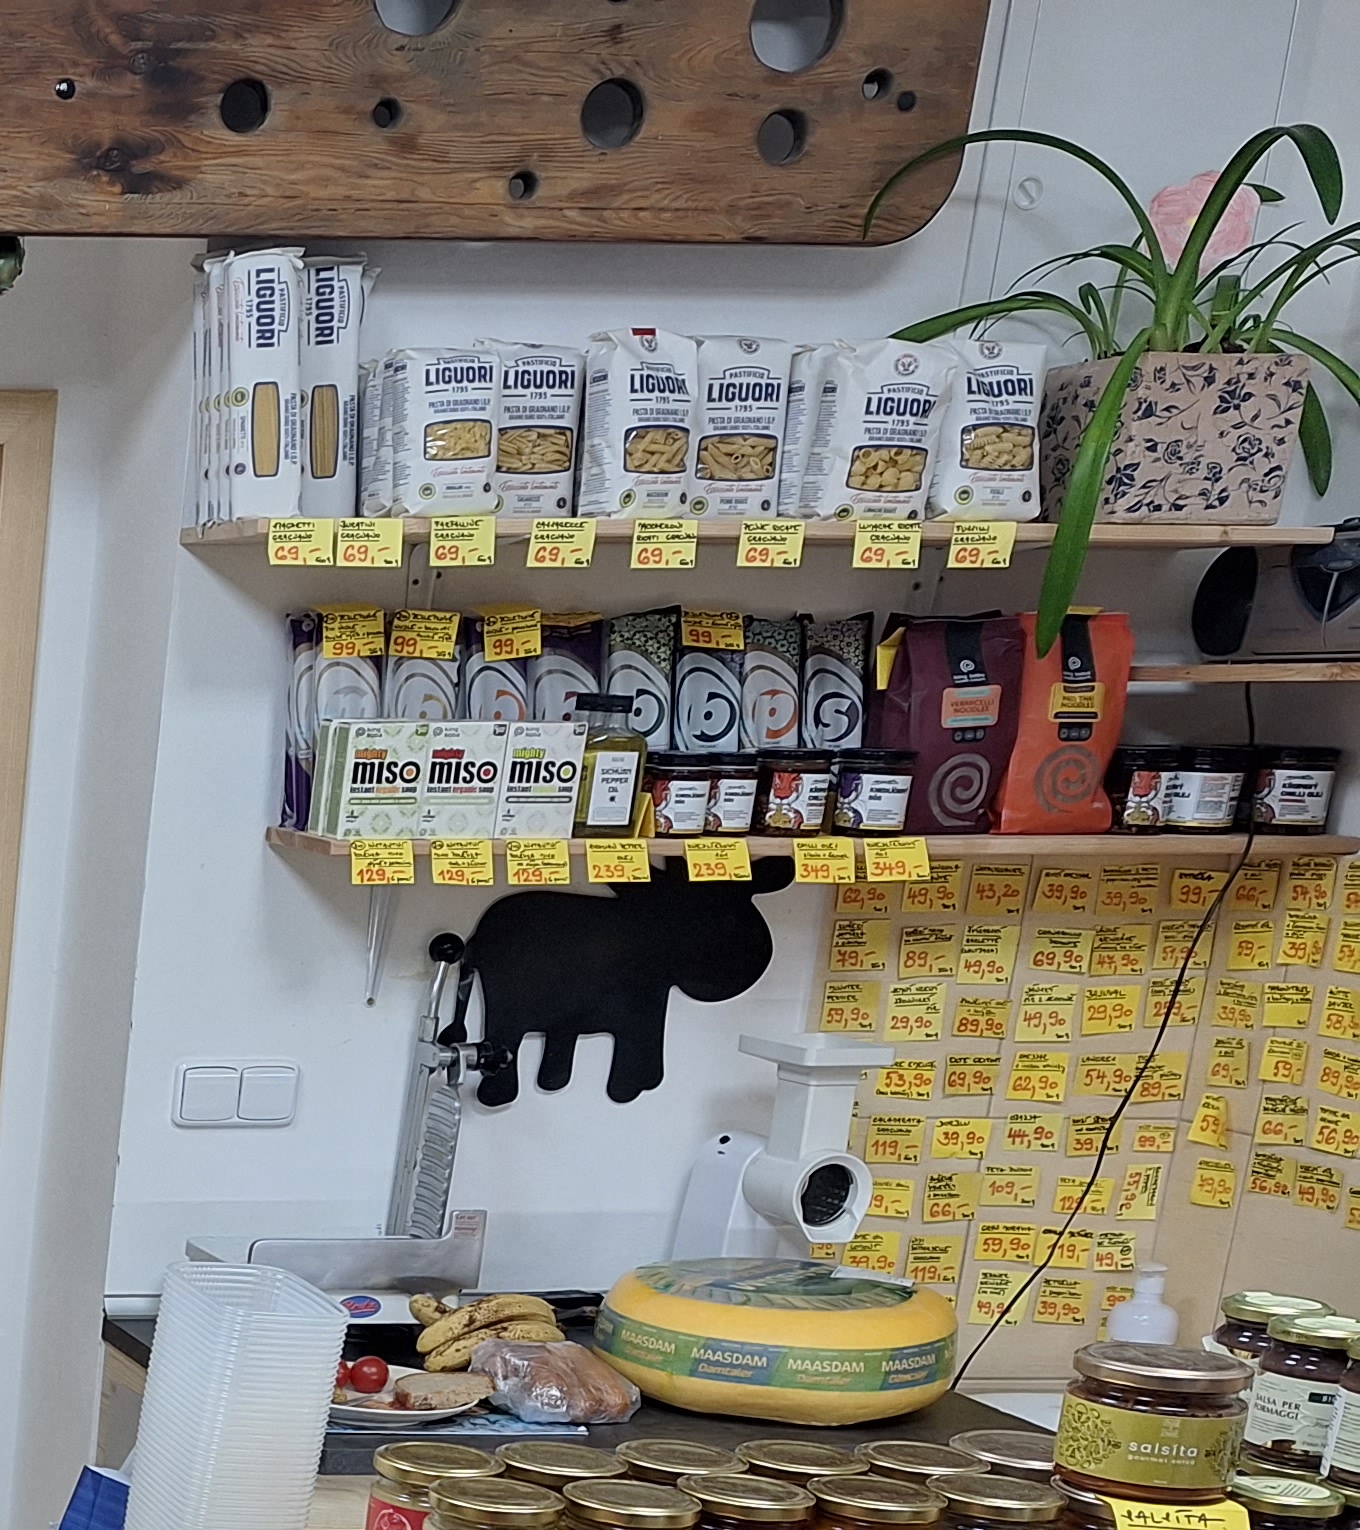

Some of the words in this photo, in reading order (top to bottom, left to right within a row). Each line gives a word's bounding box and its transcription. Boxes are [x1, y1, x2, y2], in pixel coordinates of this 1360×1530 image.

[255, 267, 276, 349] LIGUORI
[314, 266, 335, 346] LIGUORI
[424, 365, 494, 387] LIGUORI
[502, 369, 576, 390] LIGUORI
[629, 372, 690, 396] LIGUORI
[966, 373, 1034, 399] LIGUORI
[706, 379, 782, 404] LIGUORI
[864, 395, 936, 419] LIGUORI
[273, 544, 321, 566] 69,-
[352, 758, 421, 785] miso
[428, 758, 498, 785] miso
[509, 758, 576, 785] miso
[620, 1328, 676, 1354] MAASDAM
[691, 1346, 768, 1368] MAASDAM
[787, 1357, 865, 1374] MAASDAM
[881, 1352, 936, 1373] MAASDAM
[1127, 1440, 1199, 1458] salsíta
